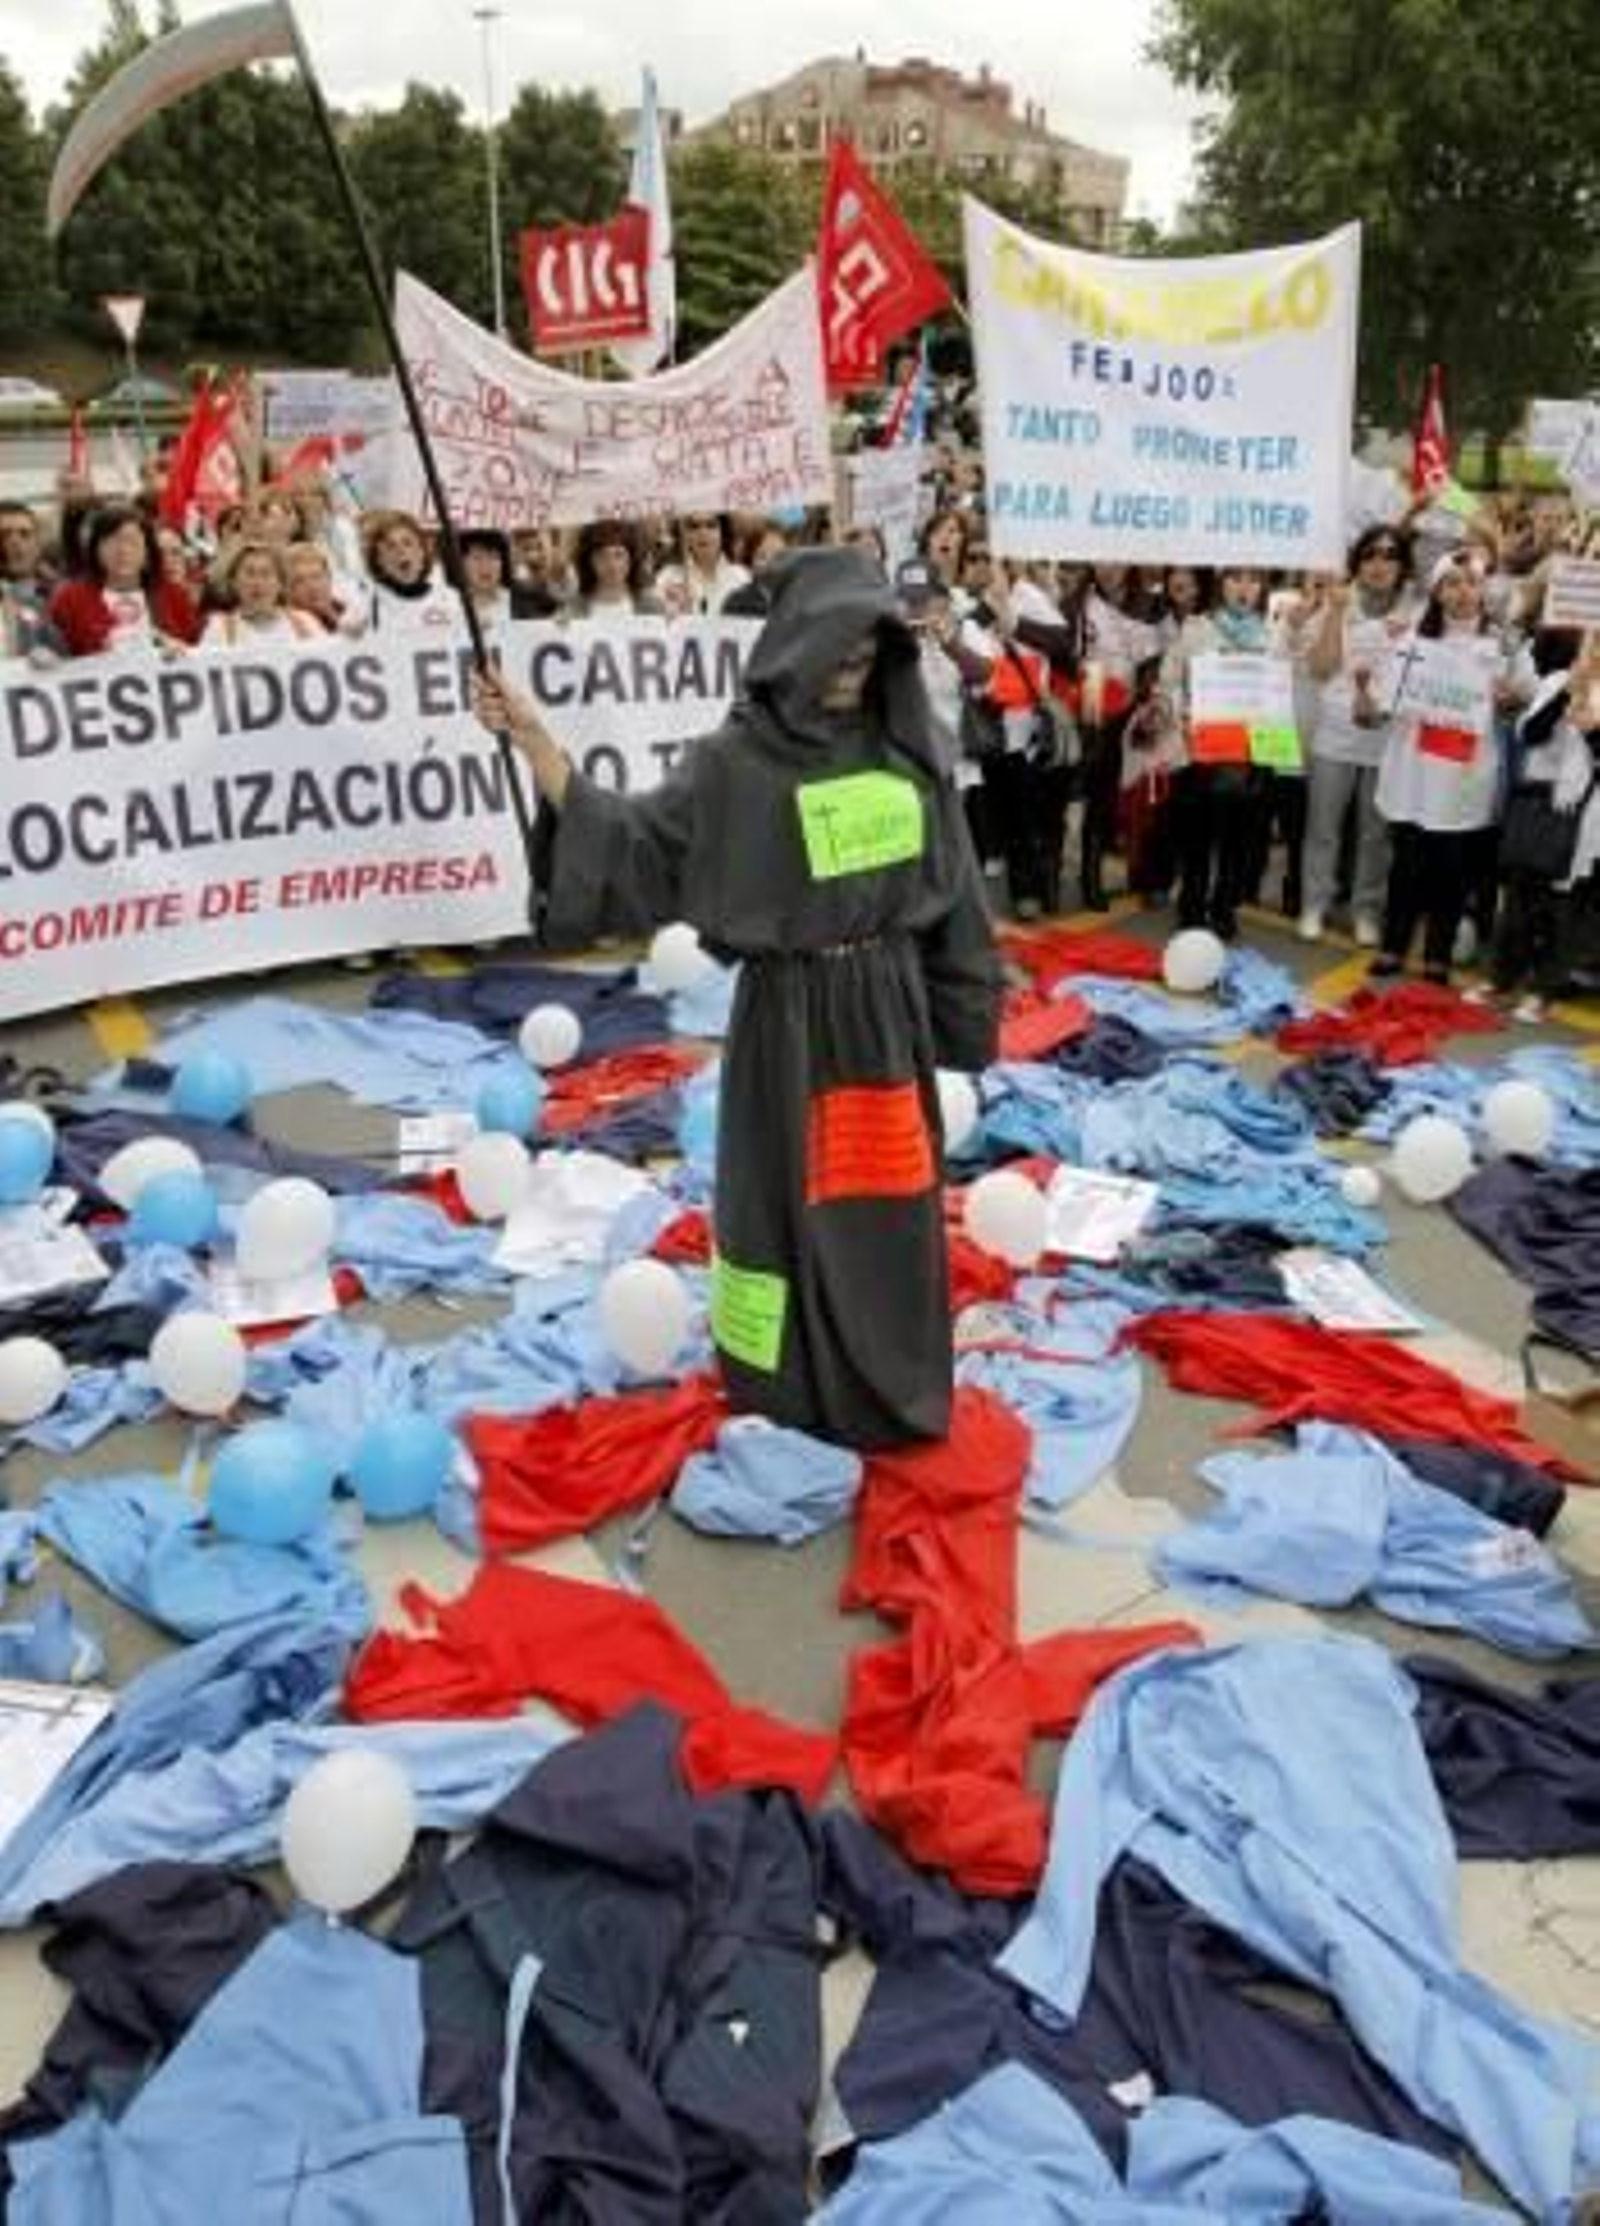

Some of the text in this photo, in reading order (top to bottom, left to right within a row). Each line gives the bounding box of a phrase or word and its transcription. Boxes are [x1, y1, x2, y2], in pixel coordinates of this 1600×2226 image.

[537, 239, 638, 315] CIG
[1007, 403, 1100, 444] TANTO
[993, 481, 1069, 520] PARA
[1091, 490, 1191, 529] LUEGO
[6, 655, 388, 758] DESPIDOS
[199, 880, 261, 918] DE
[279, 852, 498, 909] EMPRESA
